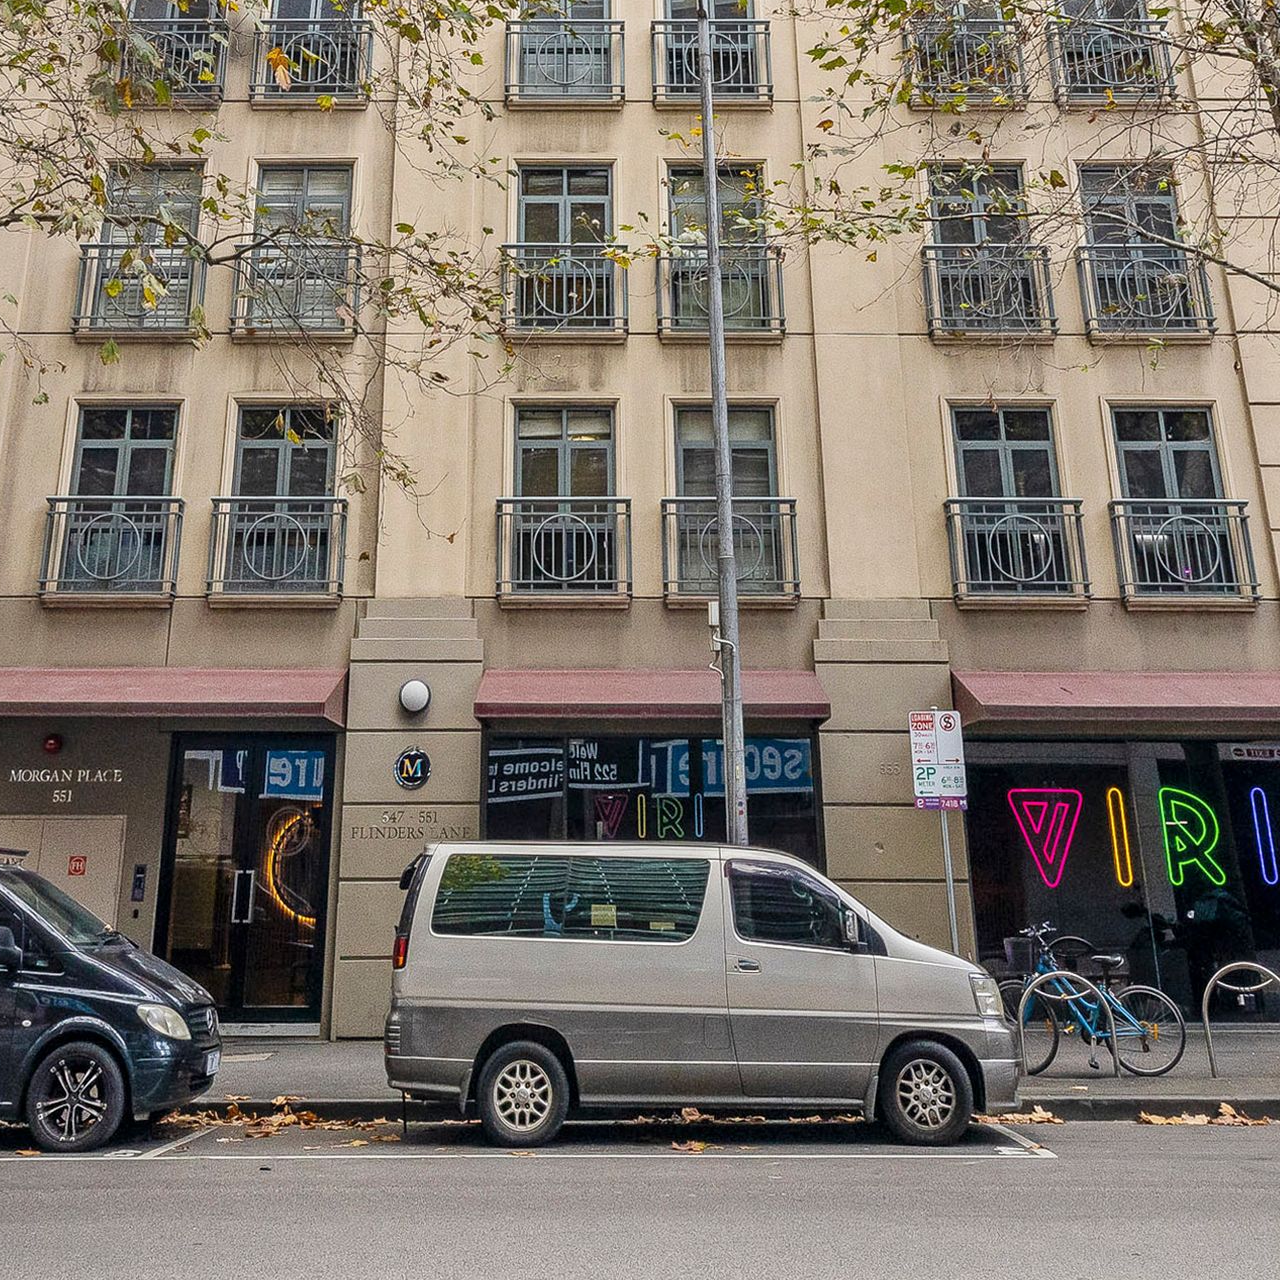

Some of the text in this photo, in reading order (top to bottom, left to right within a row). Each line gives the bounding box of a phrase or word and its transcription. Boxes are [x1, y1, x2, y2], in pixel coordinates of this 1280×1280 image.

[911, 722, 934, 730] ZONE
[401, 758, 424, 777] M
[880, 761, 901, 776] 555
[916, 766, 937, 780] 2P
[9, 769, 123, 783] MORGAN PLACE
[52, 789, 73, 803] 551
[381, 810, 405, 824] 547
[418, 811, 438, 824] 551
[351, 826, 472, 840] FLINDERS LANE
[1007, 786, 1279, 889] VIRI
